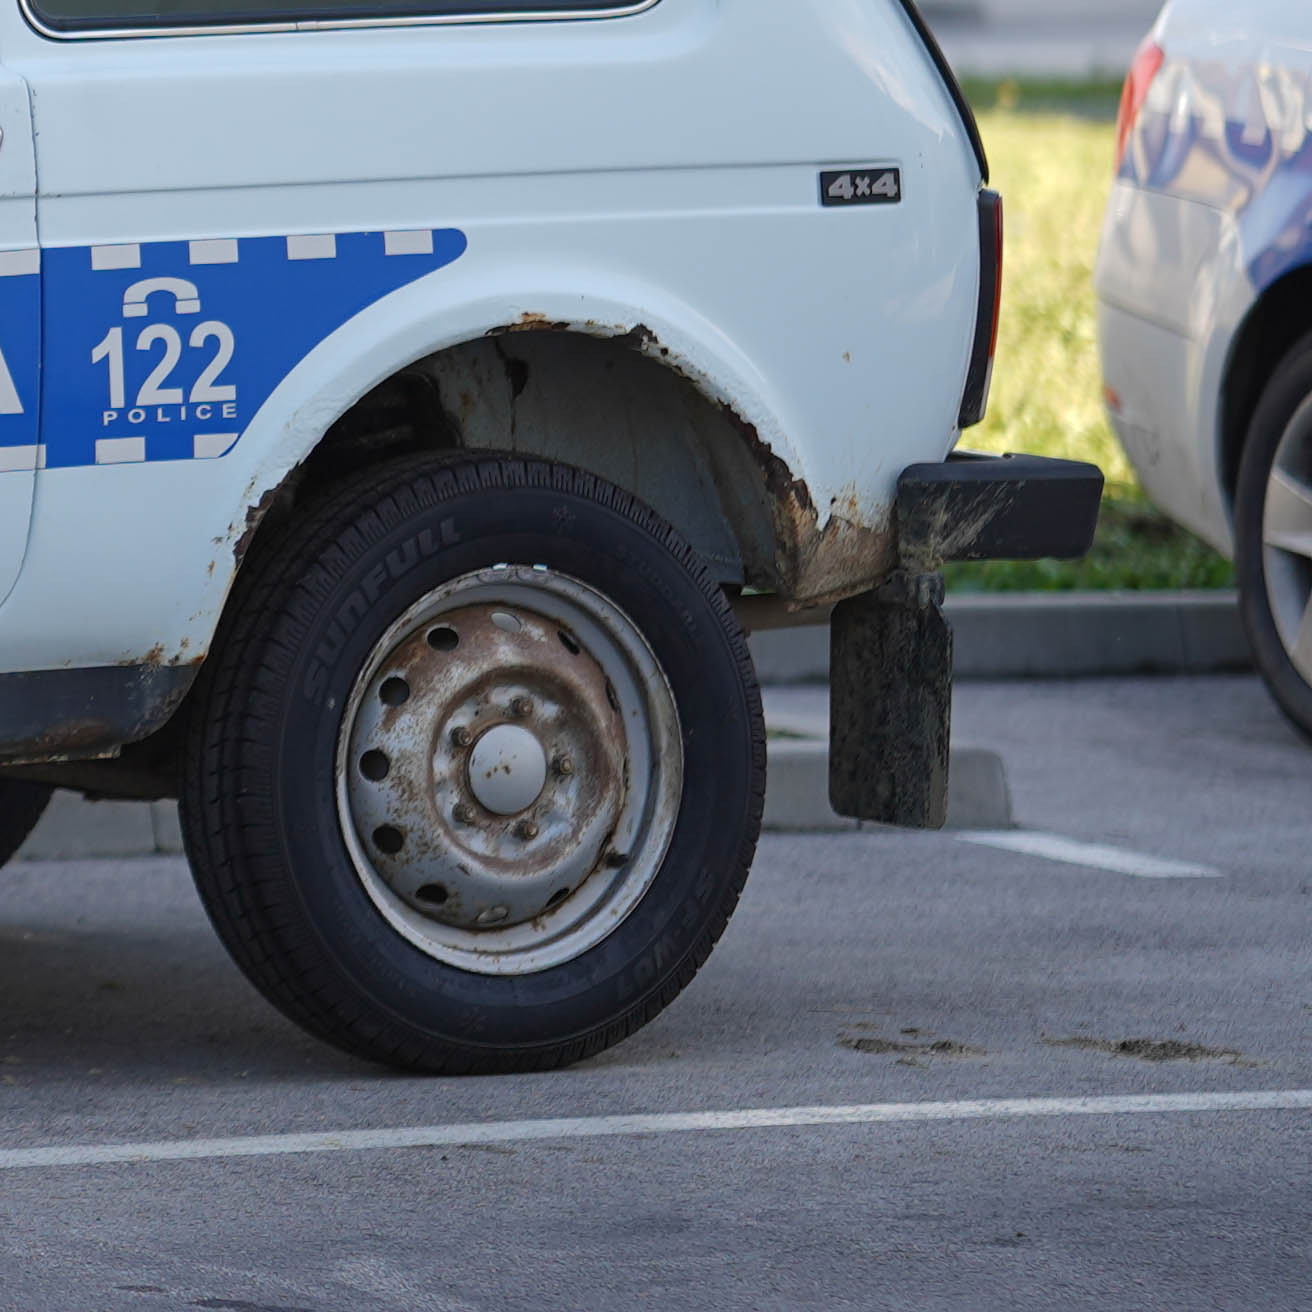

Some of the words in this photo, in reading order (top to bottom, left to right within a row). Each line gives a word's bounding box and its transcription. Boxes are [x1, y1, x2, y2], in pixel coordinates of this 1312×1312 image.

[827, 171, 898, 200] 4x4
[91, 320, 237, 409] 122
[102, 402, 237, 426] POLICE
